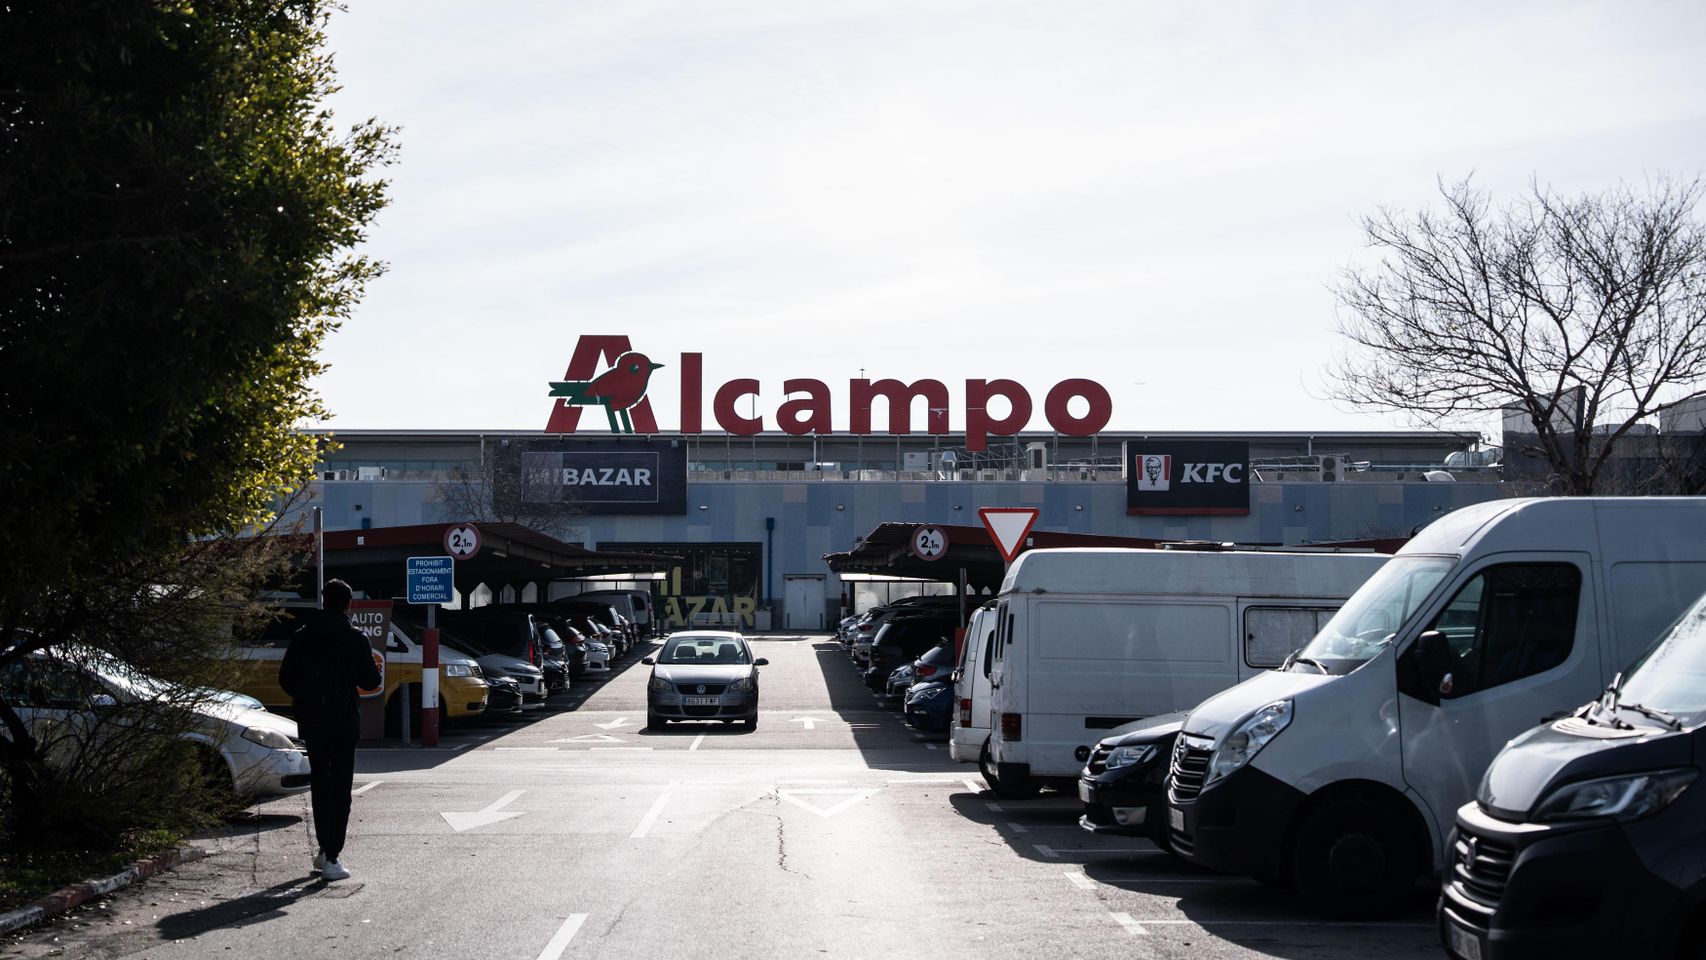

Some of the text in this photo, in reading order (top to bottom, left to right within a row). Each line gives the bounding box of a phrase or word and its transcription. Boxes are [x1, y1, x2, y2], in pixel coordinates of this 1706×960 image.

[544, 335, 1112, 451] Alcampo
[563, 468, 651, 486] BAZAR
[1180, 463, 1242, 483] KFC
[351, 613, 383, 623] AUTO
[665, 596, 755, 626] AZAR
